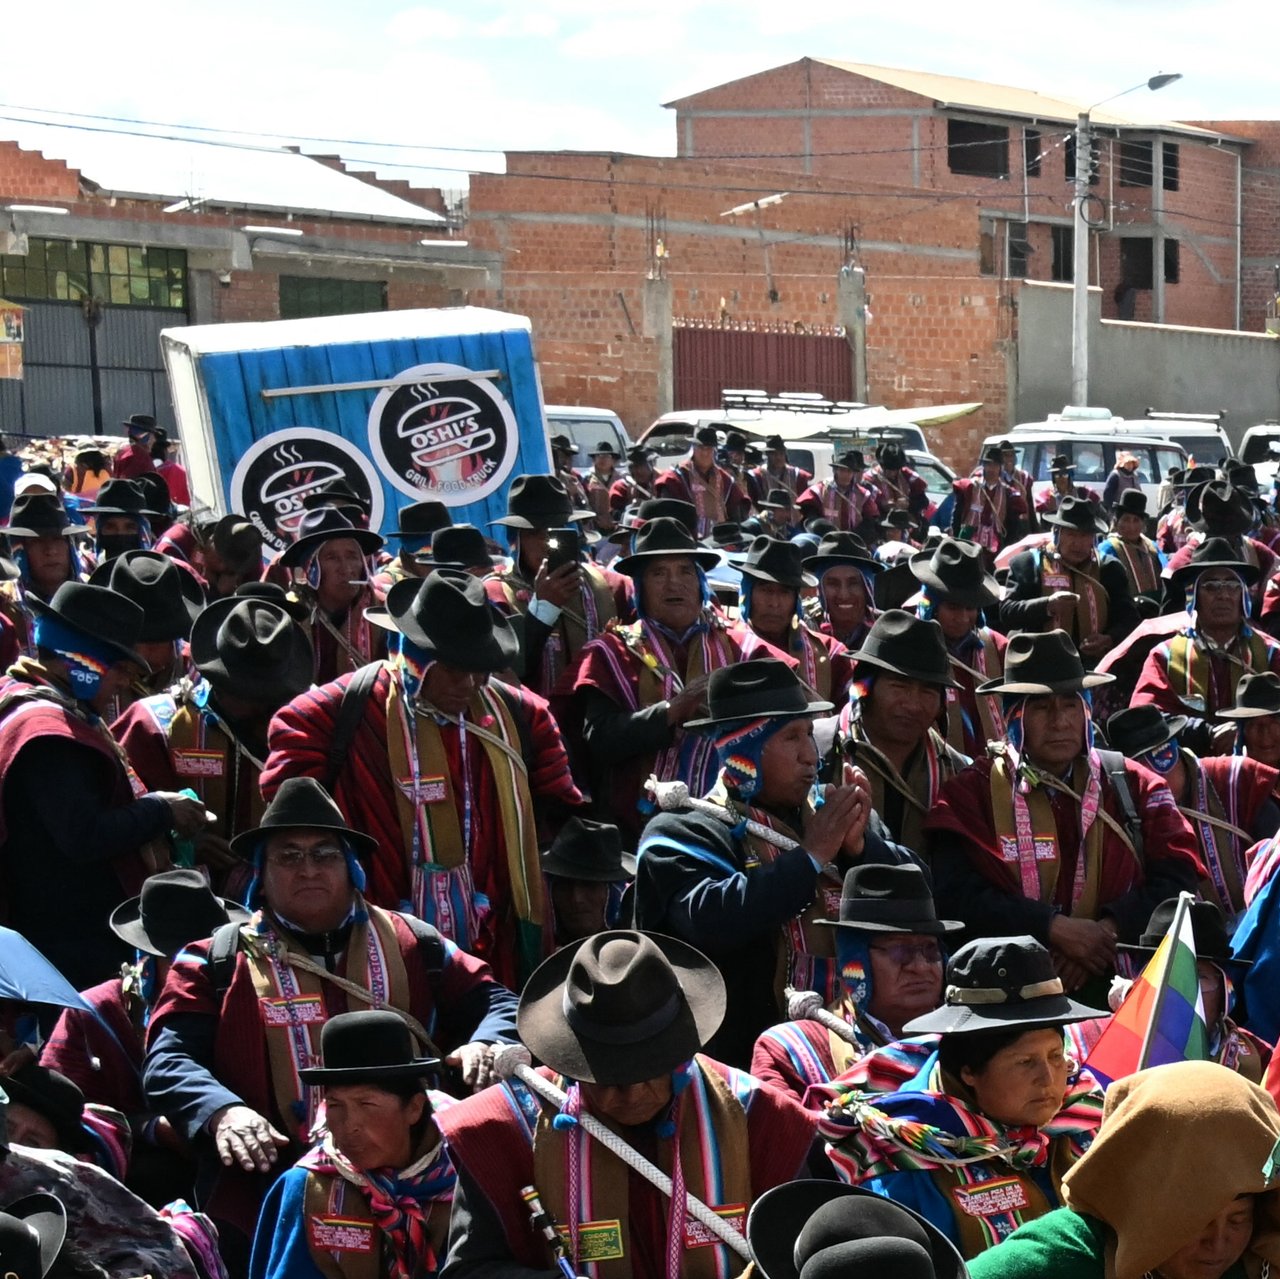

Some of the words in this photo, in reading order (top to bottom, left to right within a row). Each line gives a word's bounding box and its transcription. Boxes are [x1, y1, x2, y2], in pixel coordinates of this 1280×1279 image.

[411, 417, 479, 448] OSHI'S
[405, 469, 436, 489] GRILL
[437, 481, 467, 492] FOOD
[466, 458, 497, 486] TRUCK
[250, 511, 276, 543] CAMION
